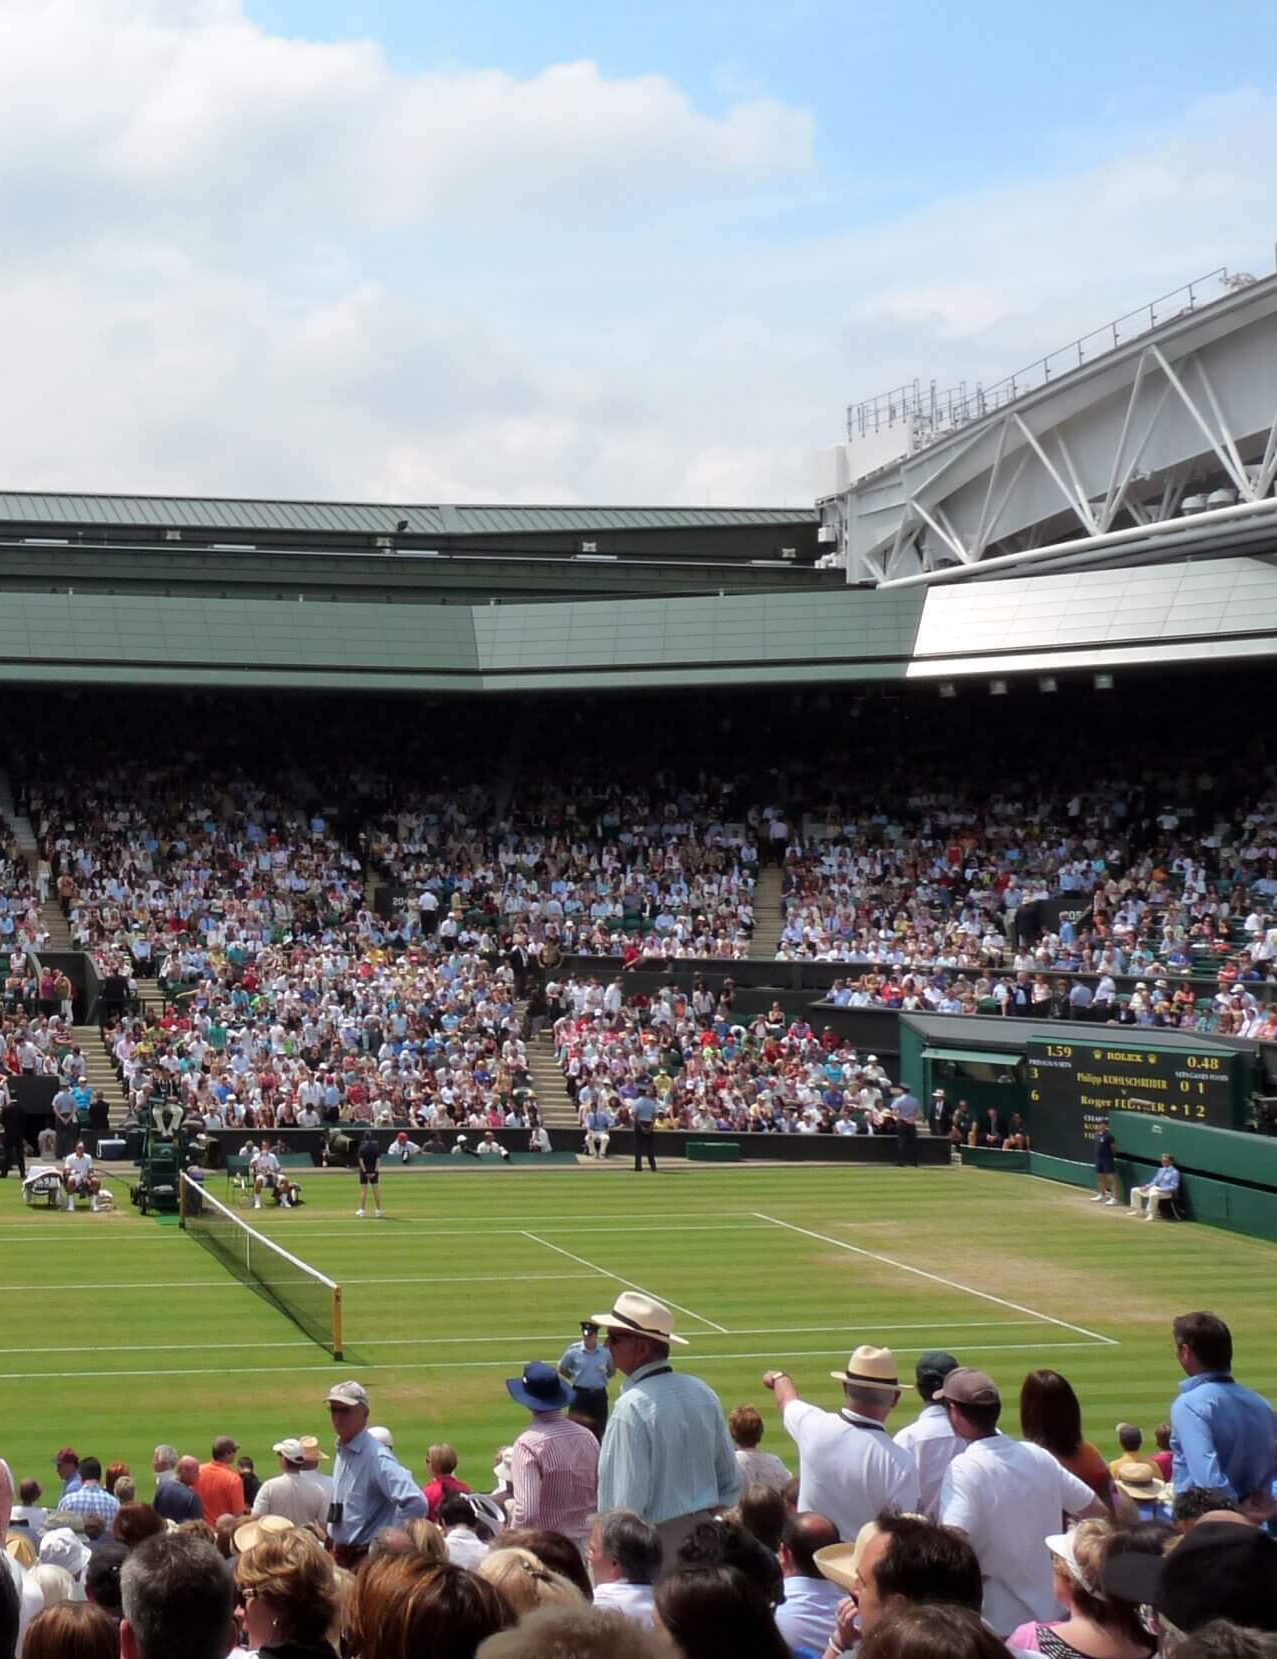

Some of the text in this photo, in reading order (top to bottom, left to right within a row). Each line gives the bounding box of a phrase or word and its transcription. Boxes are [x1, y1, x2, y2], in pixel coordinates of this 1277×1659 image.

[1046, 1045, 1073, 1058] 1.59
[1106, 1052, 1143, 1063] ROLEX
[1186, 1055, 1219, 1070] 0.48
[1030, 1067, 1039, 1079] 3
[1077, 1071, 1167, 1090] Philipp KOHLSCHREIBER
[1180, 1081, 1190, 1092] 0
[1197, 1082, 1204, 1094] 1
[1031, 1090, 1040, 1101] 6
[1081, 1095, 1113, 1109] Roger
[1183, 1104, 1189, 1116] 1
[1195, 1105, 1206, 1118] 2
